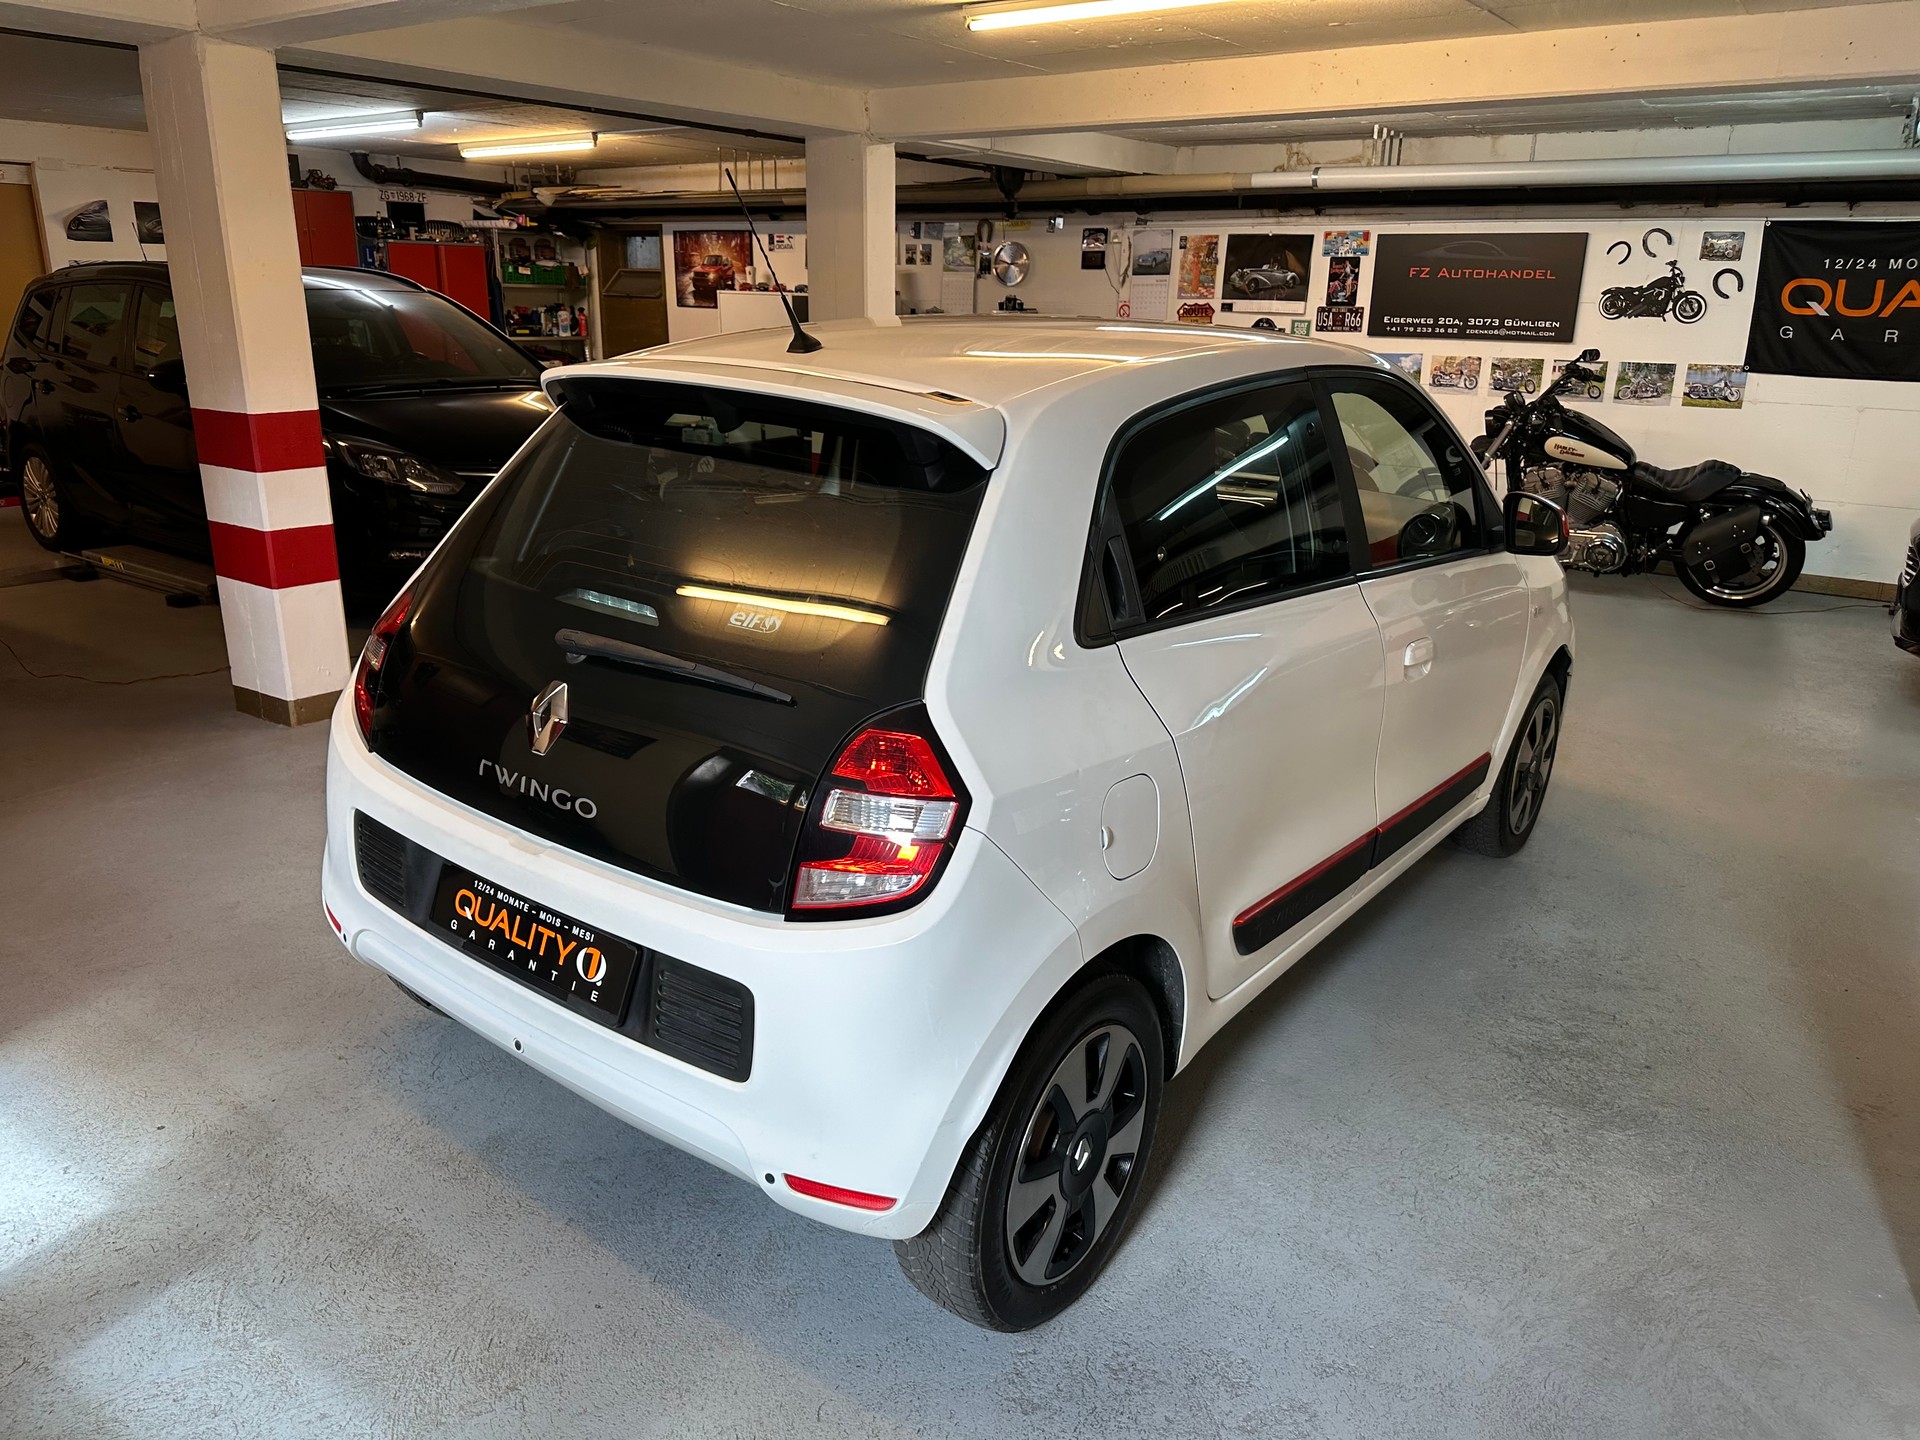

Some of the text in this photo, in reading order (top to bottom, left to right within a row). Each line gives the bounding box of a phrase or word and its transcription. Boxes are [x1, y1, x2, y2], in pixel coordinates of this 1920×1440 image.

[379, 189, 390, 200] ZG
[1823, 258, 1919, 270] 12/24 MO
[1409, 267, 1556, 280] FZ AUTOHANDEL
[1781, 278, 1920, 318] QUA
[1183, 307, 1209, 316] ROUTE
[1317, 312, 1361, 327] USA R66
[1383, 316, 1560, 328] EIGERWEG 20A, 3073 GÜMLIGEN
[729, 611, 765, 628] elf
[479, 759, 597, 818] TWINGO
[474, 880, 495, 896] 12/24
[497, 890, 530, 913] MONATE
[539, 910, 562, 928] MOIS
[572, 925, 595, 943] MESI
[455, 889, 577, 966] QUALITY
[450, 919, 599, 1002] GARANTIE
